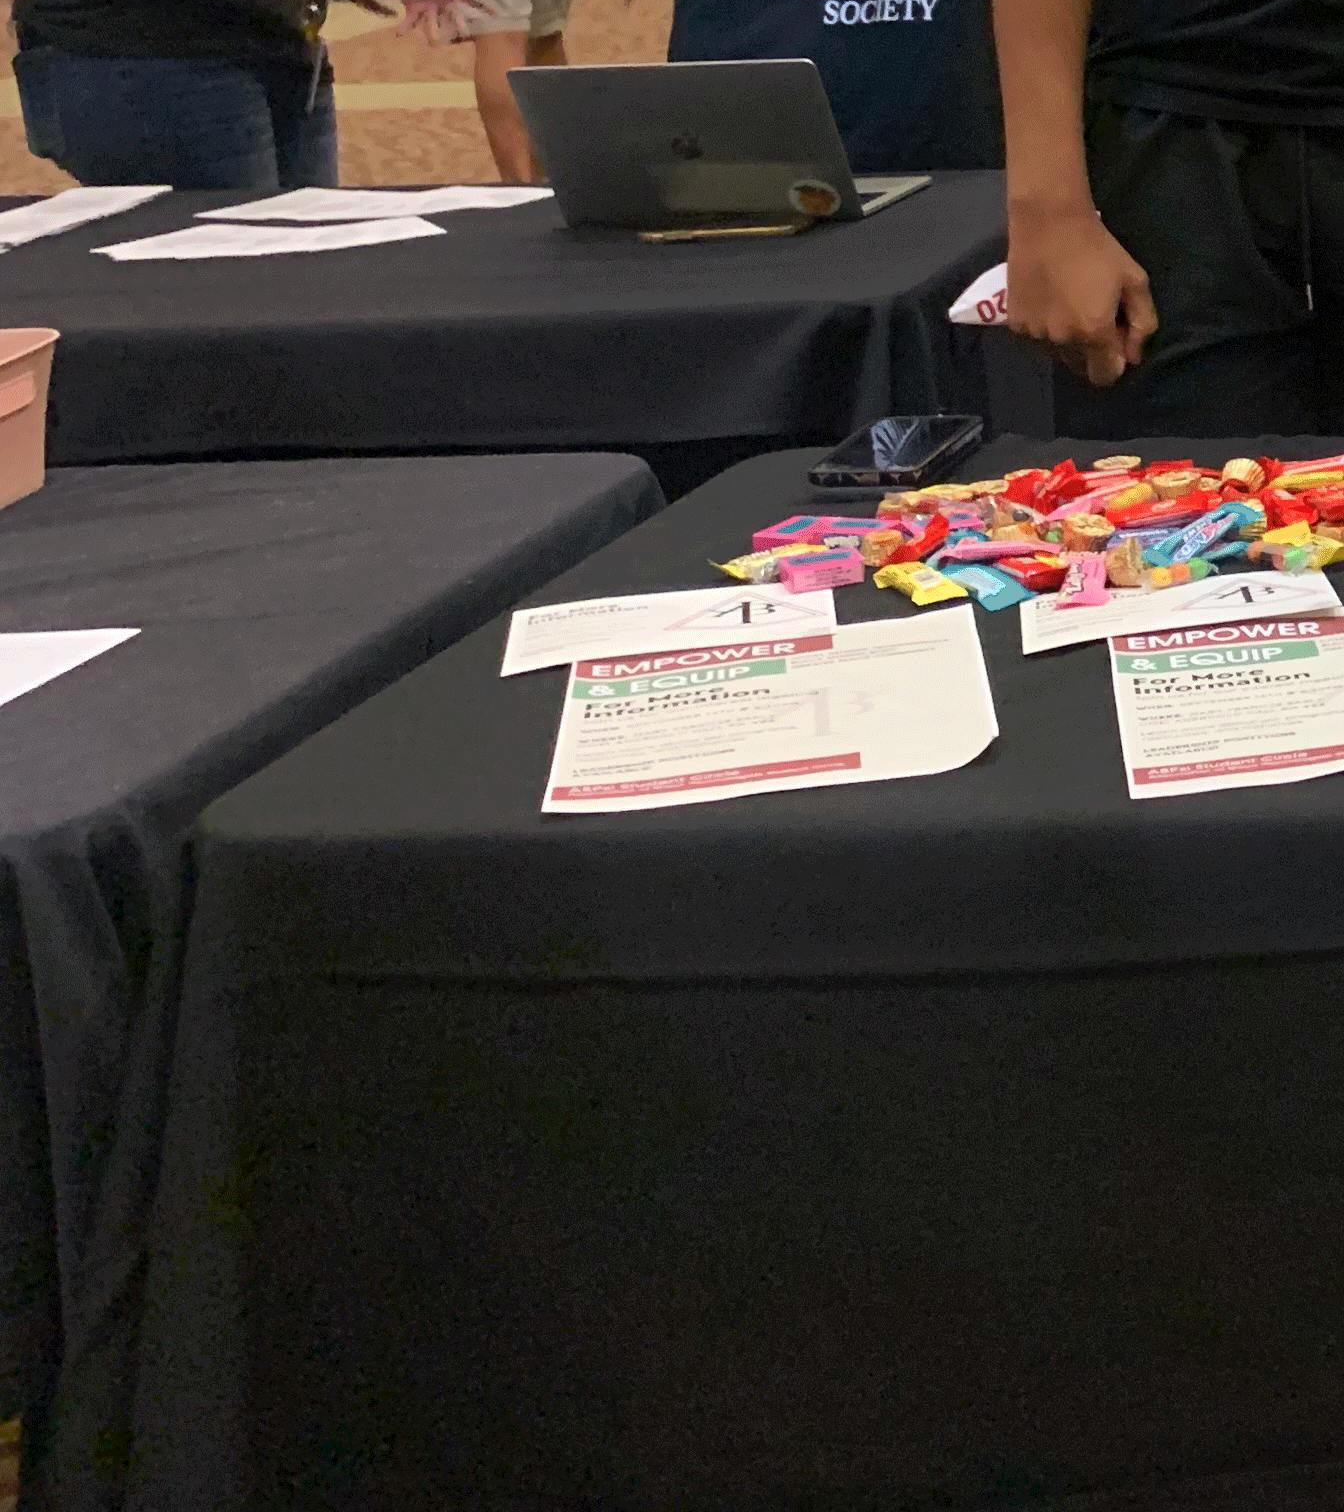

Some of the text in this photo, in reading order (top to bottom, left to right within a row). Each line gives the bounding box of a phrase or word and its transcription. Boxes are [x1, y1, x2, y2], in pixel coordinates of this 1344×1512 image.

[1127, 621, 1321, 651] EMPOWER
[592, 641, 797, 678] EMPOWER
[1131, 646, 1283, 671] & EQUIP
[587, 665, 752, 697] & EQUIP
[1133, 668, 1265, 686] For More
[1134, 671, 1311, 695] Information
[584, 687, 771, 719] Information
[585, 687, 725, 710] For More
